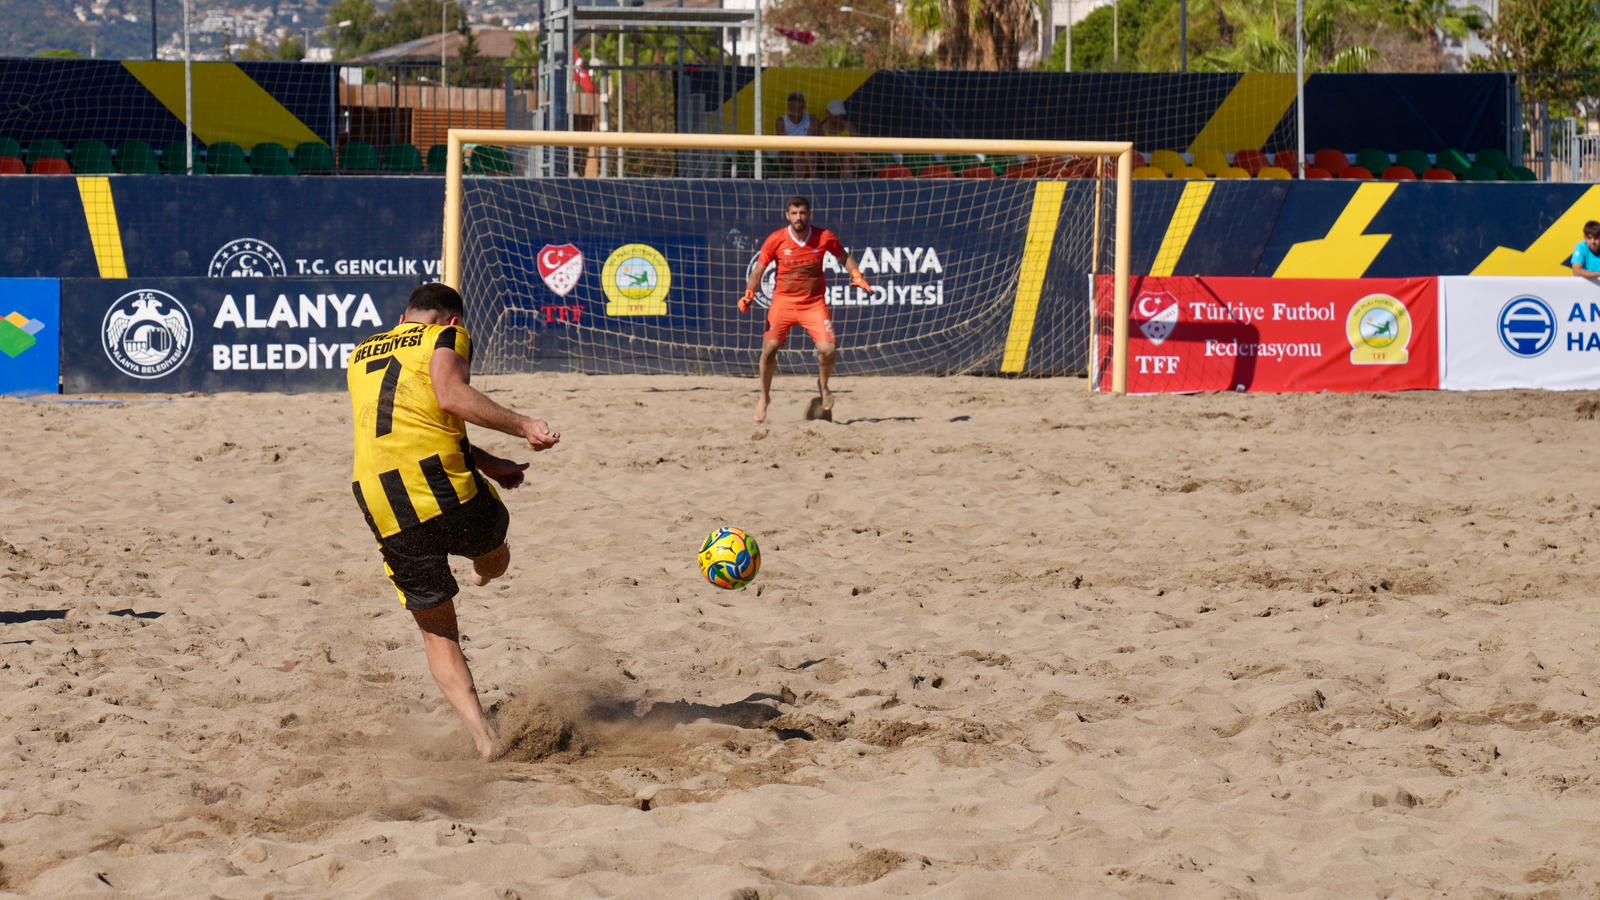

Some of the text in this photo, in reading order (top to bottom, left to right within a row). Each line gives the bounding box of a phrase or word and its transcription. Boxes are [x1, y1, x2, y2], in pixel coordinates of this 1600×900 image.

[296, 259, 329, 275] T.C.
[335, 257, 418, 276] GENÇLİK
[822, 247, 943, 273] AANYA
[213, 293, 383, 329] ALANYA
[541, 305, 585, 323] TFF
[1189, 302, 1264, 325] Türkiye
[1272, 302, 1335, 321] Futbol
[1204, 339, 1322, 361] Federasyonu
[1567, 331, 1600, 352] HA
[1135, 355, 1181, 375] TFF
[366, 355, 402, 438] 7
